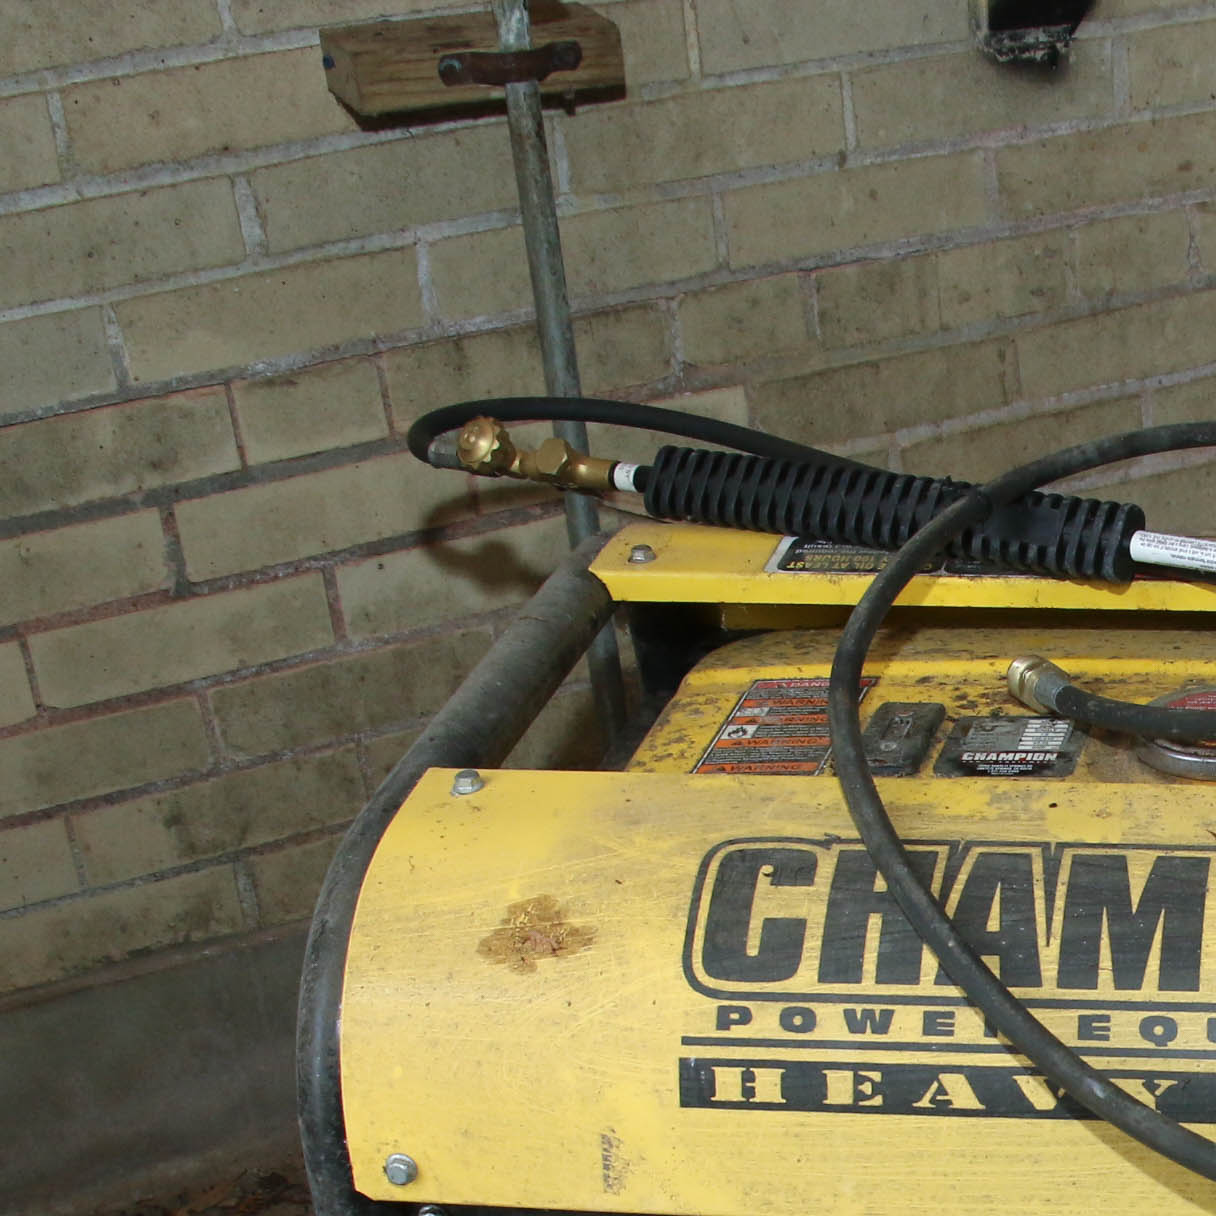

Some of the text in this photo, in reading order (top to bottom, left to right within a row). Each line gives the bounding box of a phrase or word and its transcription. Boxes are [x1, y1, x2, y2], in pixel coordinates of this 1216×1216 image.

[962, 752, 1058, 761] CHAMPION
[716, 1005, 1002, 1039] POWE
[710, 1066, 1179, 1113] HEAVY
